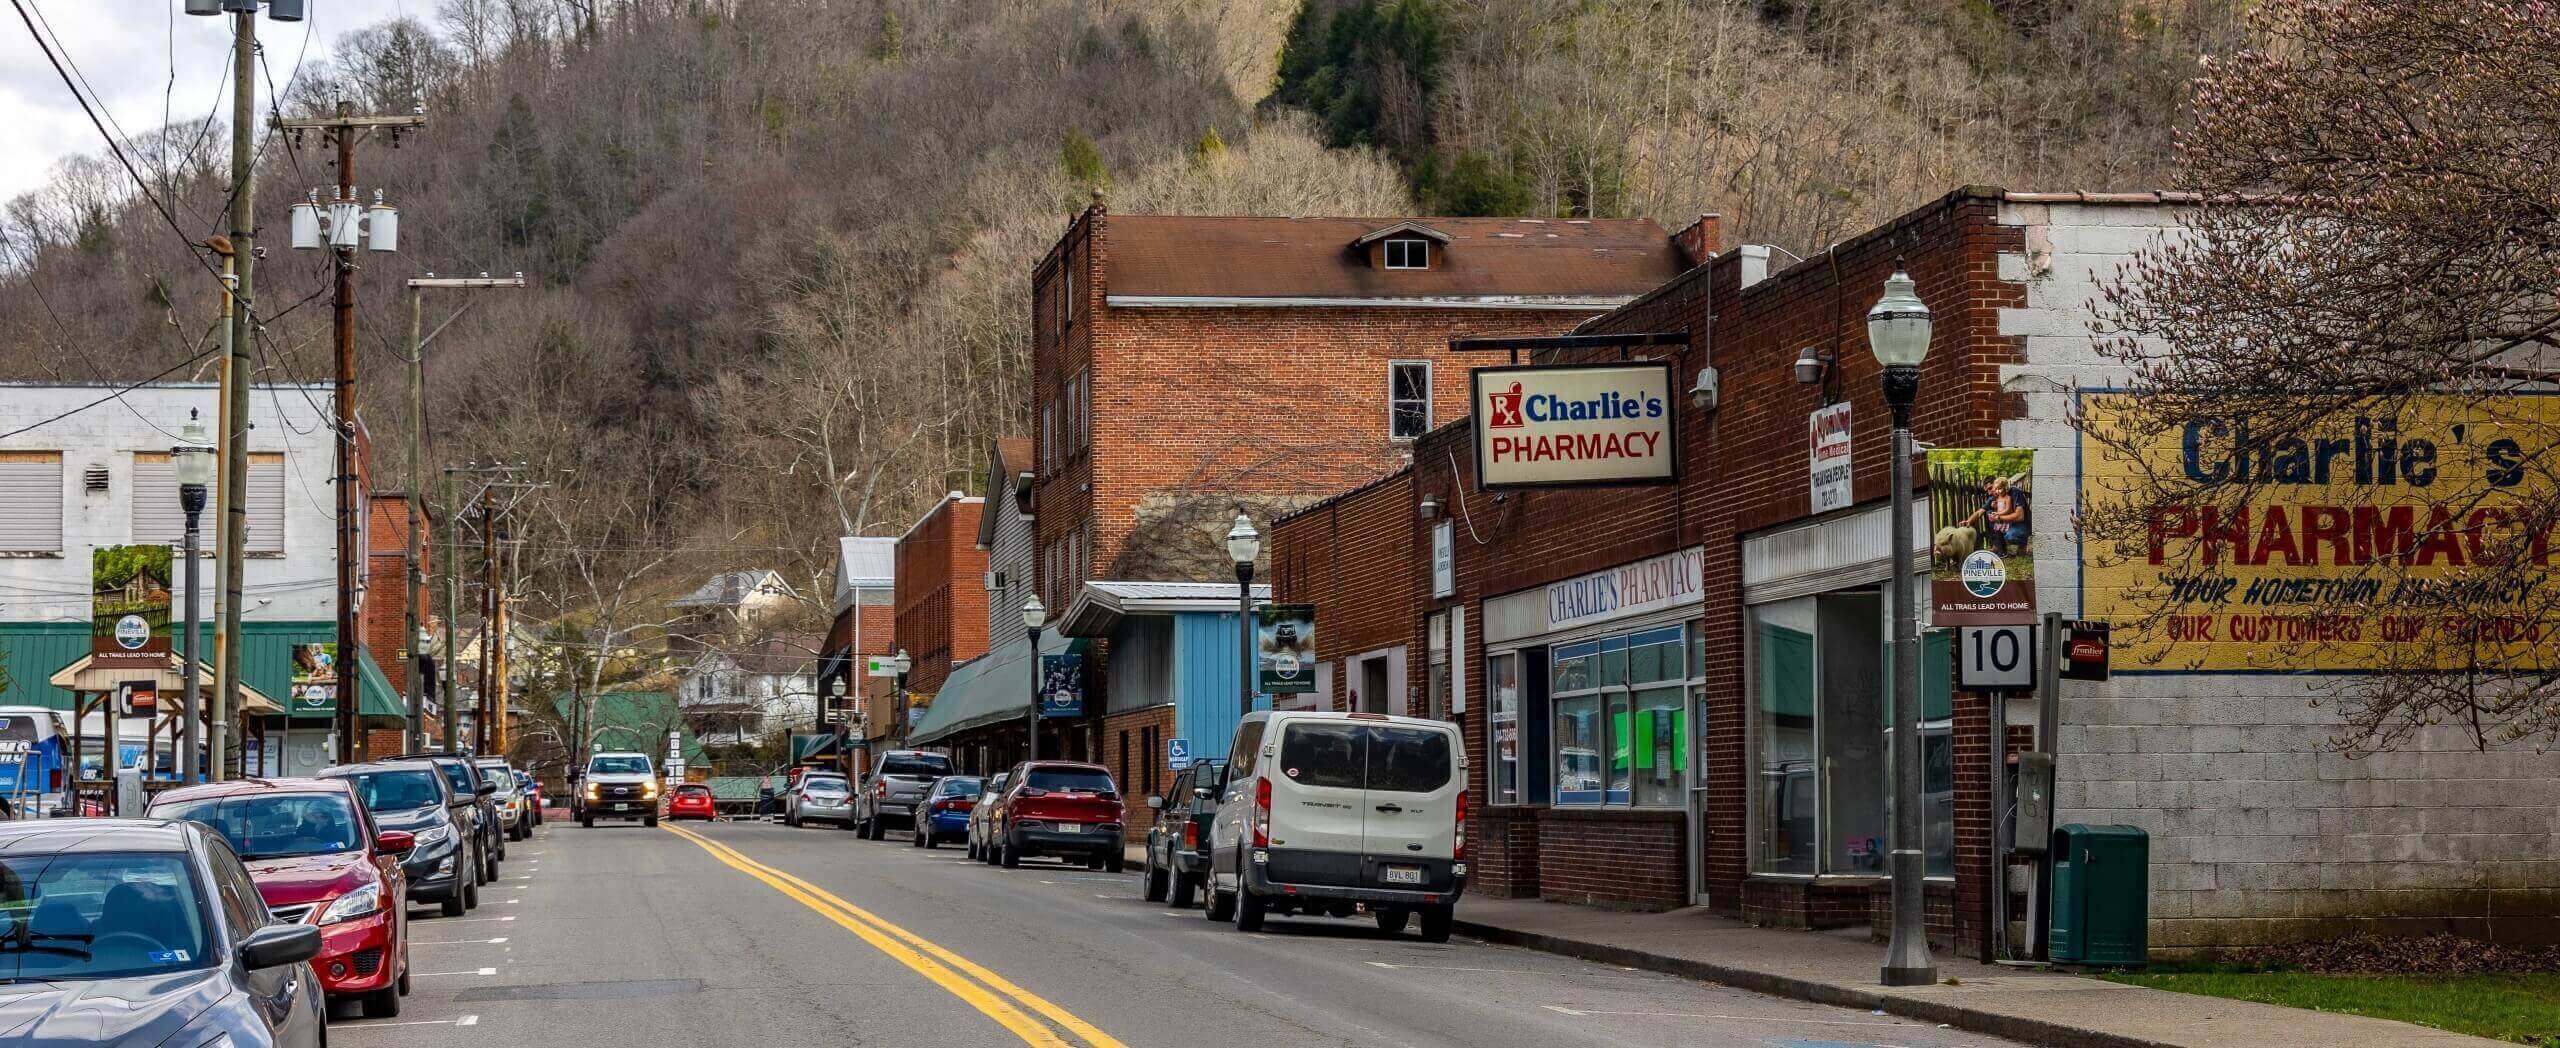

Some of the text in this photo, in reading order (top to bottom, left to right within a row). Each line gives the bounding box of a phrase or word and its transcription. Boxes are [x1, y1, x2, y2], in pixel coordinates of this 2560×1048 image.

[1525, 390, 1663, 422] Charlie's
[1492, 431, 1661, 464] PHARMACY
[2182, 413, 2525, 487] Charlie's
[2147, 503, 2559, 567] PHARMACY
[1963, 568, 2003, 577] PINEVILLE
[1549, 571, 1618, 624] CHARLIE'S
[2243, 574, 2383, 606] HOMETOWN
[1941, 603, 1954, 611] ALL
[2007, 602, 2029, 610] HOME
[1971, 629, 2020, 673] 10
[1300, 801, 1341, 809] TRANSIT
